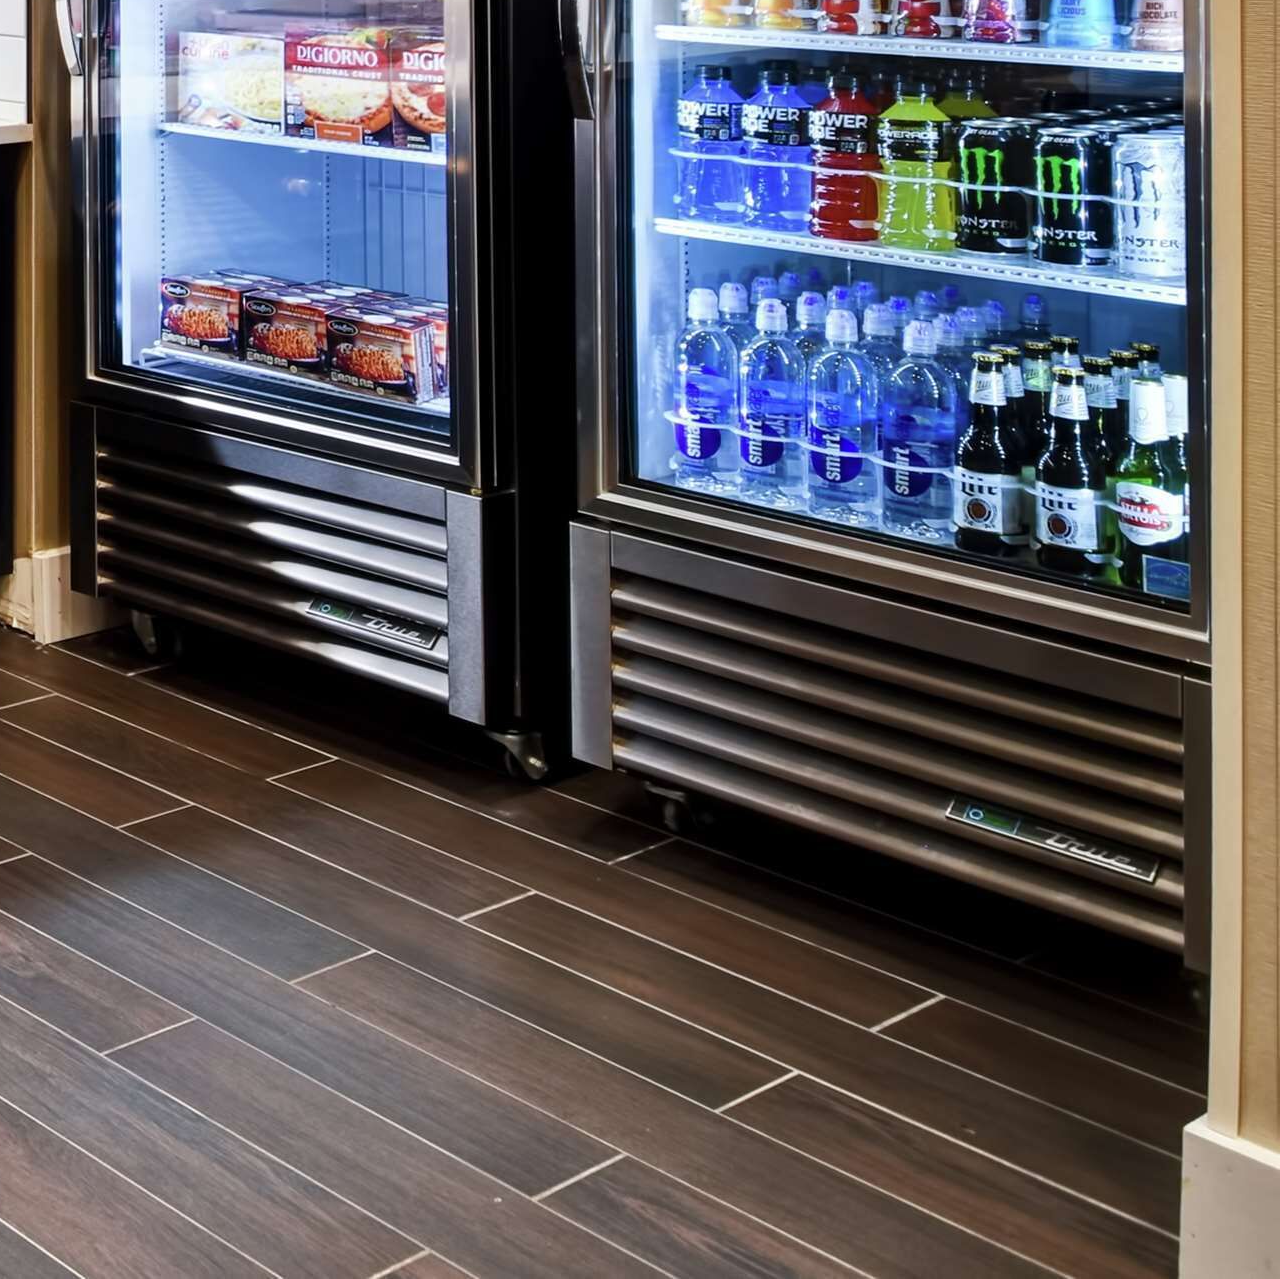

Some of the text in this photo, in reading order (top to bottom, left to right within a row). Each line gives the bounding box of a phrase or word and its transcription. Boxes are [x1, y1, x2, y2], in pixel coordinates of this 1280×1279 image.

[297, 44, 378, 67] DIGIORNO
[403, 51, 445, 71] DIGI
[292, 64, 383, 80] TRADITIONAL CRUST
[809, 110, 869, 129] POWER
